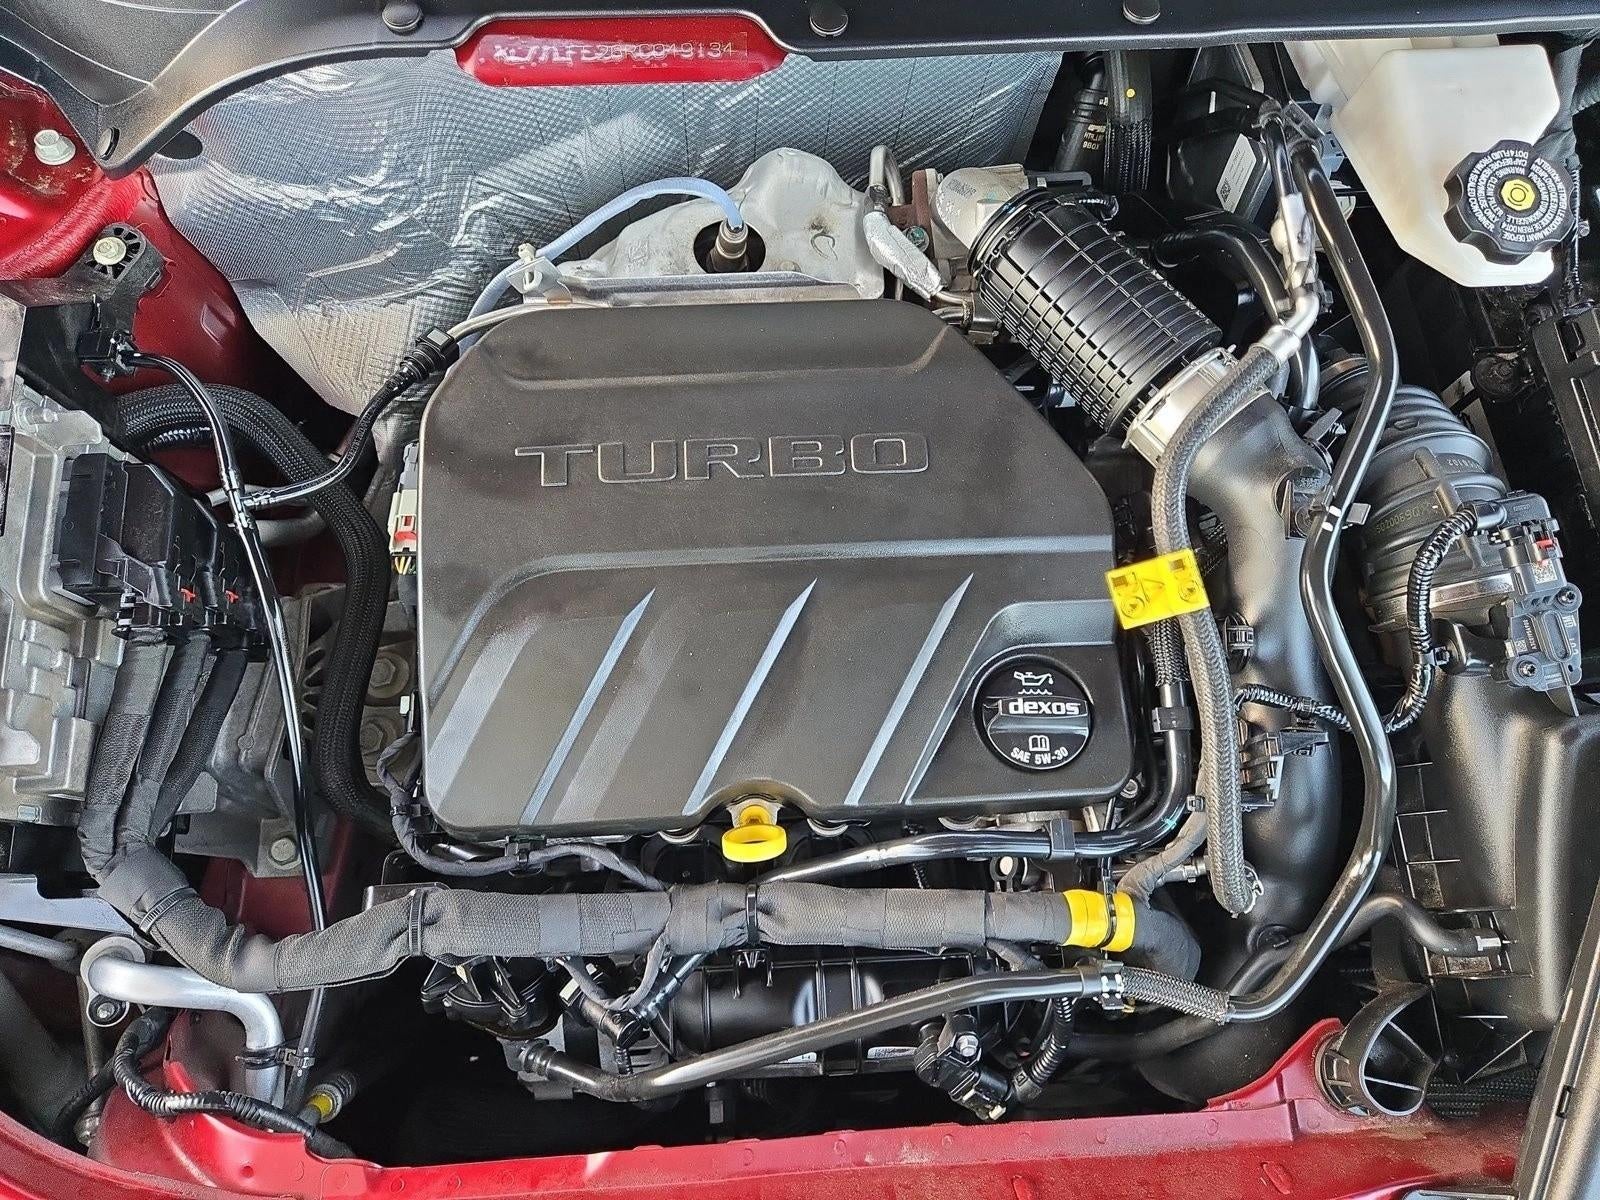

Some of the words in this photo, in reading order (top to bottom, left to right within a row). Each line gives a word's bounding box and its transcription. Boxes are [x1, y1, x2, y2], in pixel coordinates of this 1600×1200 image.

[1491, 150, 1510, 160] FLUID
[1514, 158, 1528, 167] CAP
[1515, 150, 1528, 159] DOT
[1475, 155, 1493, 171] FROM
[1489, 158, 1513, 171] BEFORE
[1486, 176, 1498, 196] CLEAN
[1487, 197, 1504, 217] FILLER
[514, 432, 929, 488] TURBO
[1009, 698, 1081, 715] dexos
[1010, 747, 1031, 764] SAE
[1034, 746, 1069, 765] 5W-30
